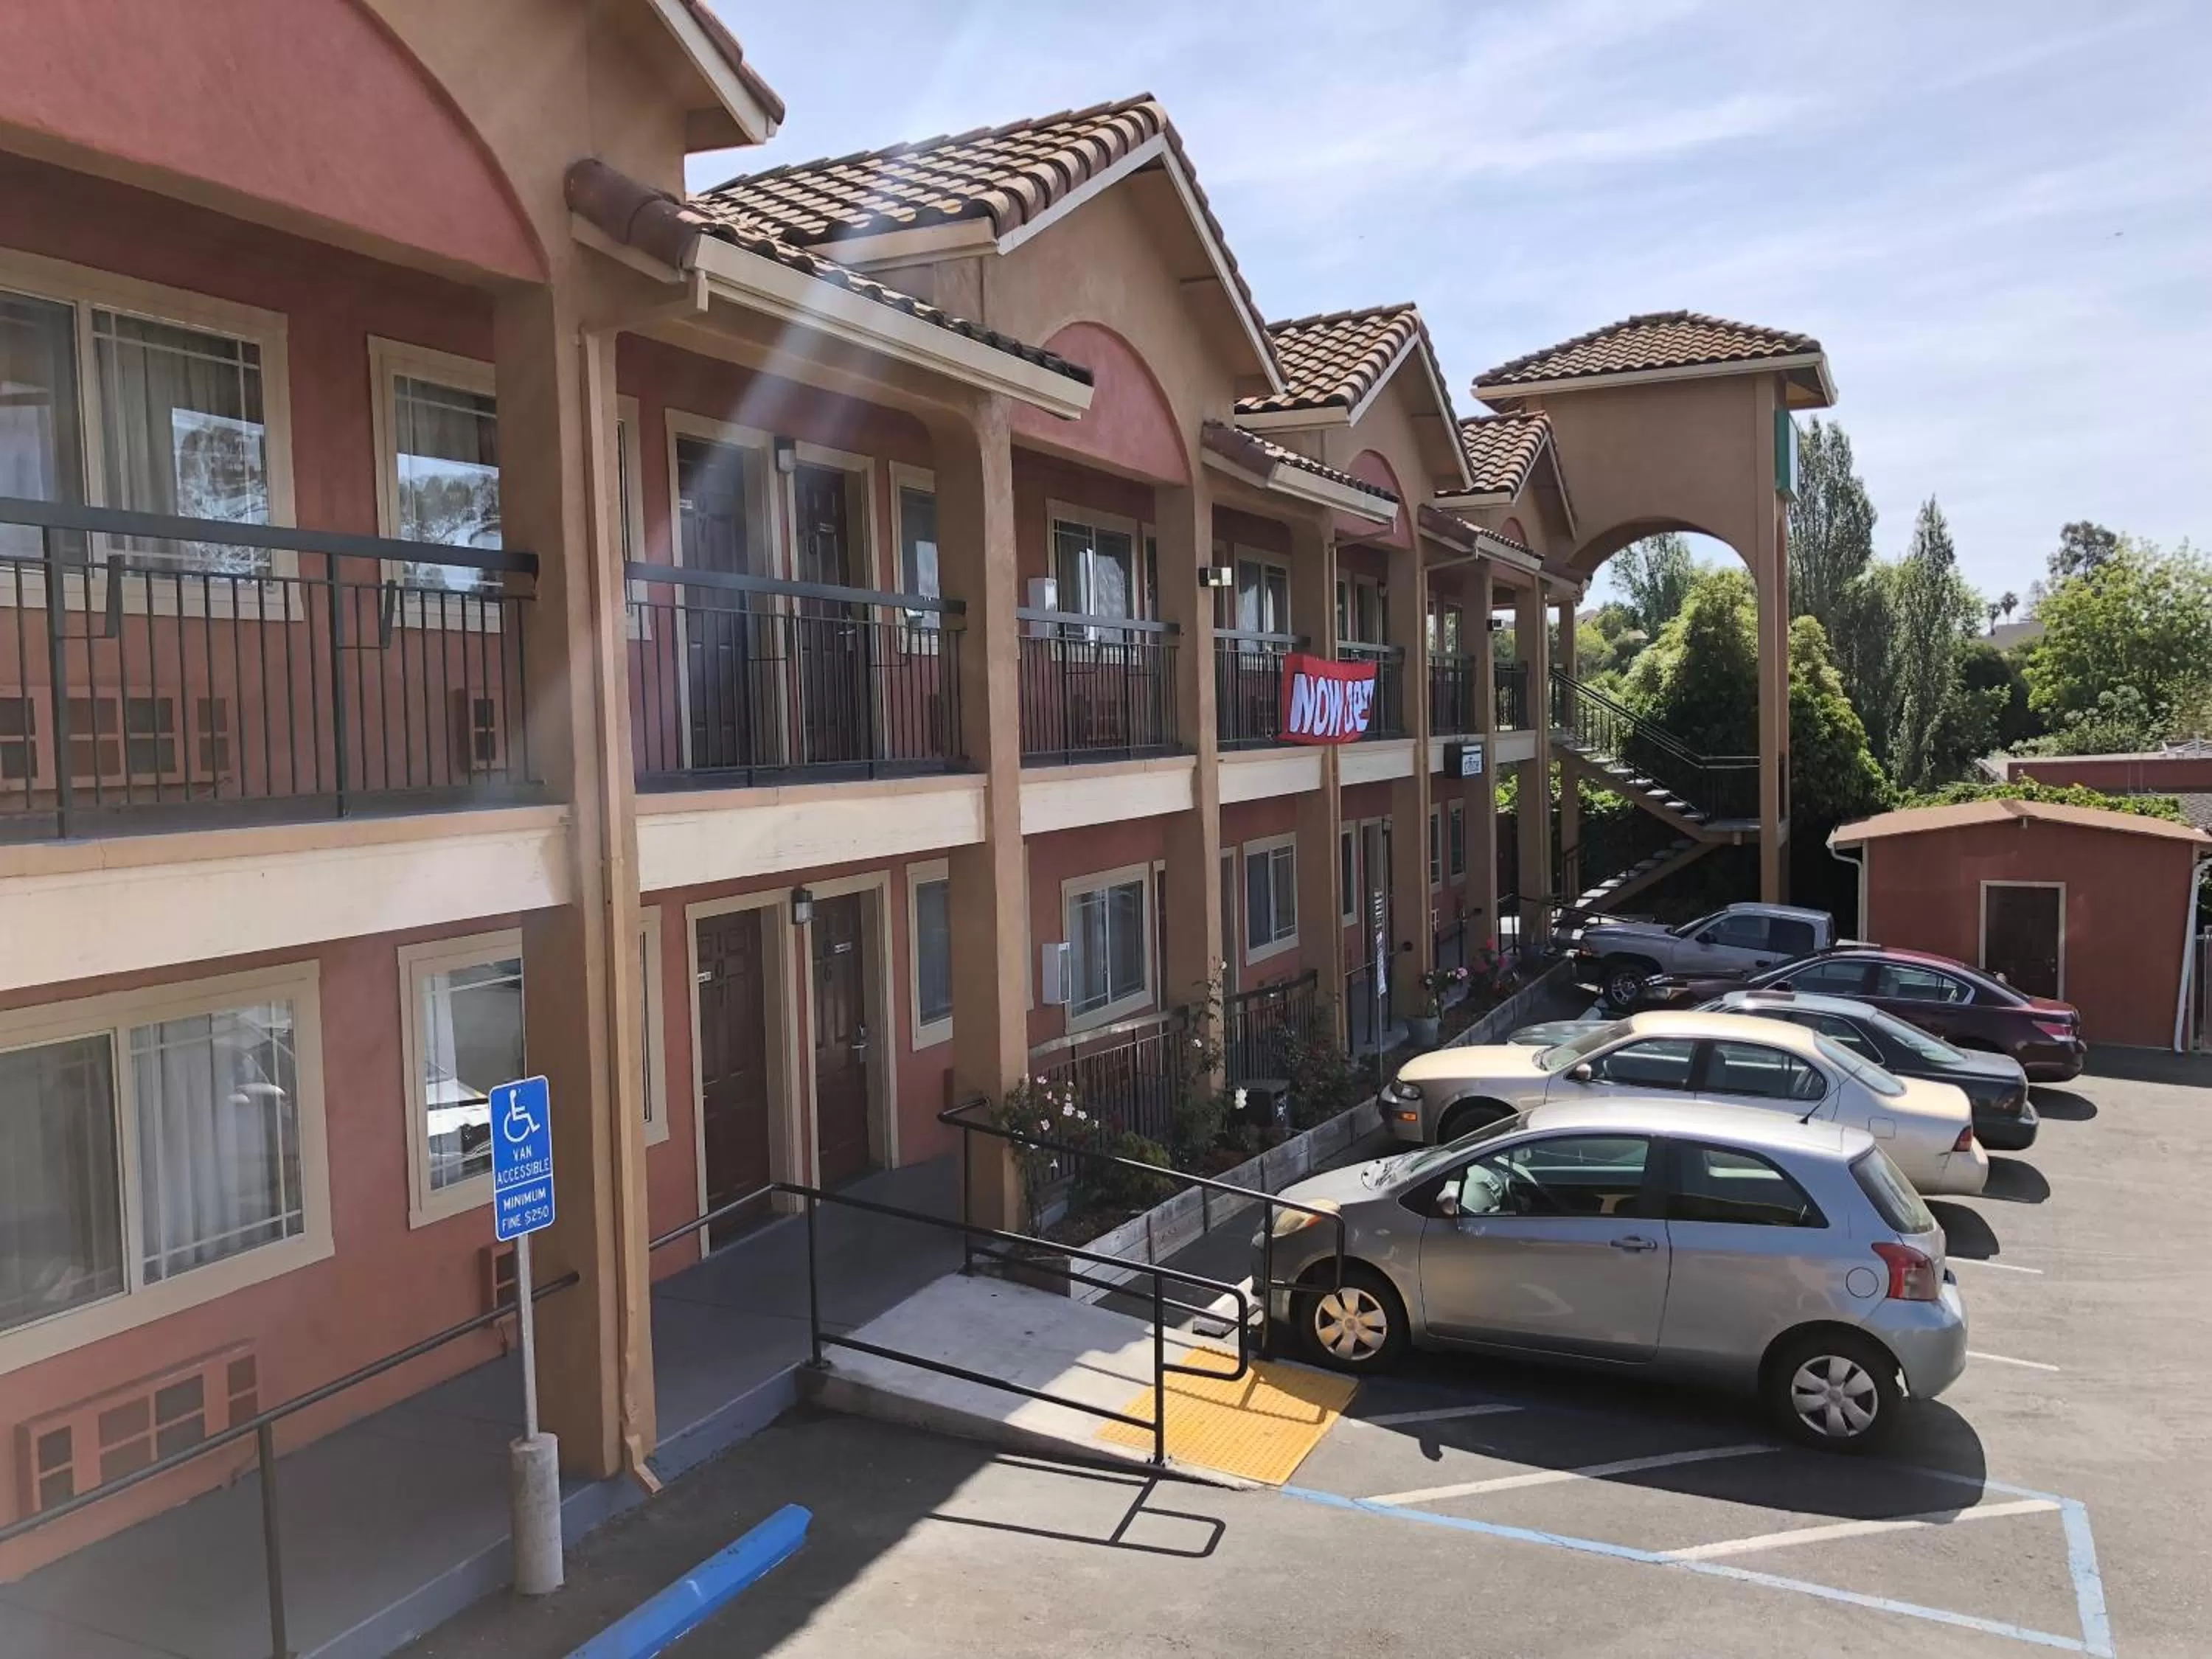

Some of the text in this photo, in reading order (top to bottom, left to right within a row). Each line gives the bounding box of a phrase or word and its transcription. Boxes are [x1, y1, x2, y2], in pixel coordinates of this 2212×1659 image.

[1290, 673, 1343, 737] NOW
[513, 1144, 532, 1161] VAN
[497, 1157, 549, 1189] ACCESSIBLE
[503, 1186, 546, 1212] MINIMUM
[502, 1205, 549, 1232] FINE $250
